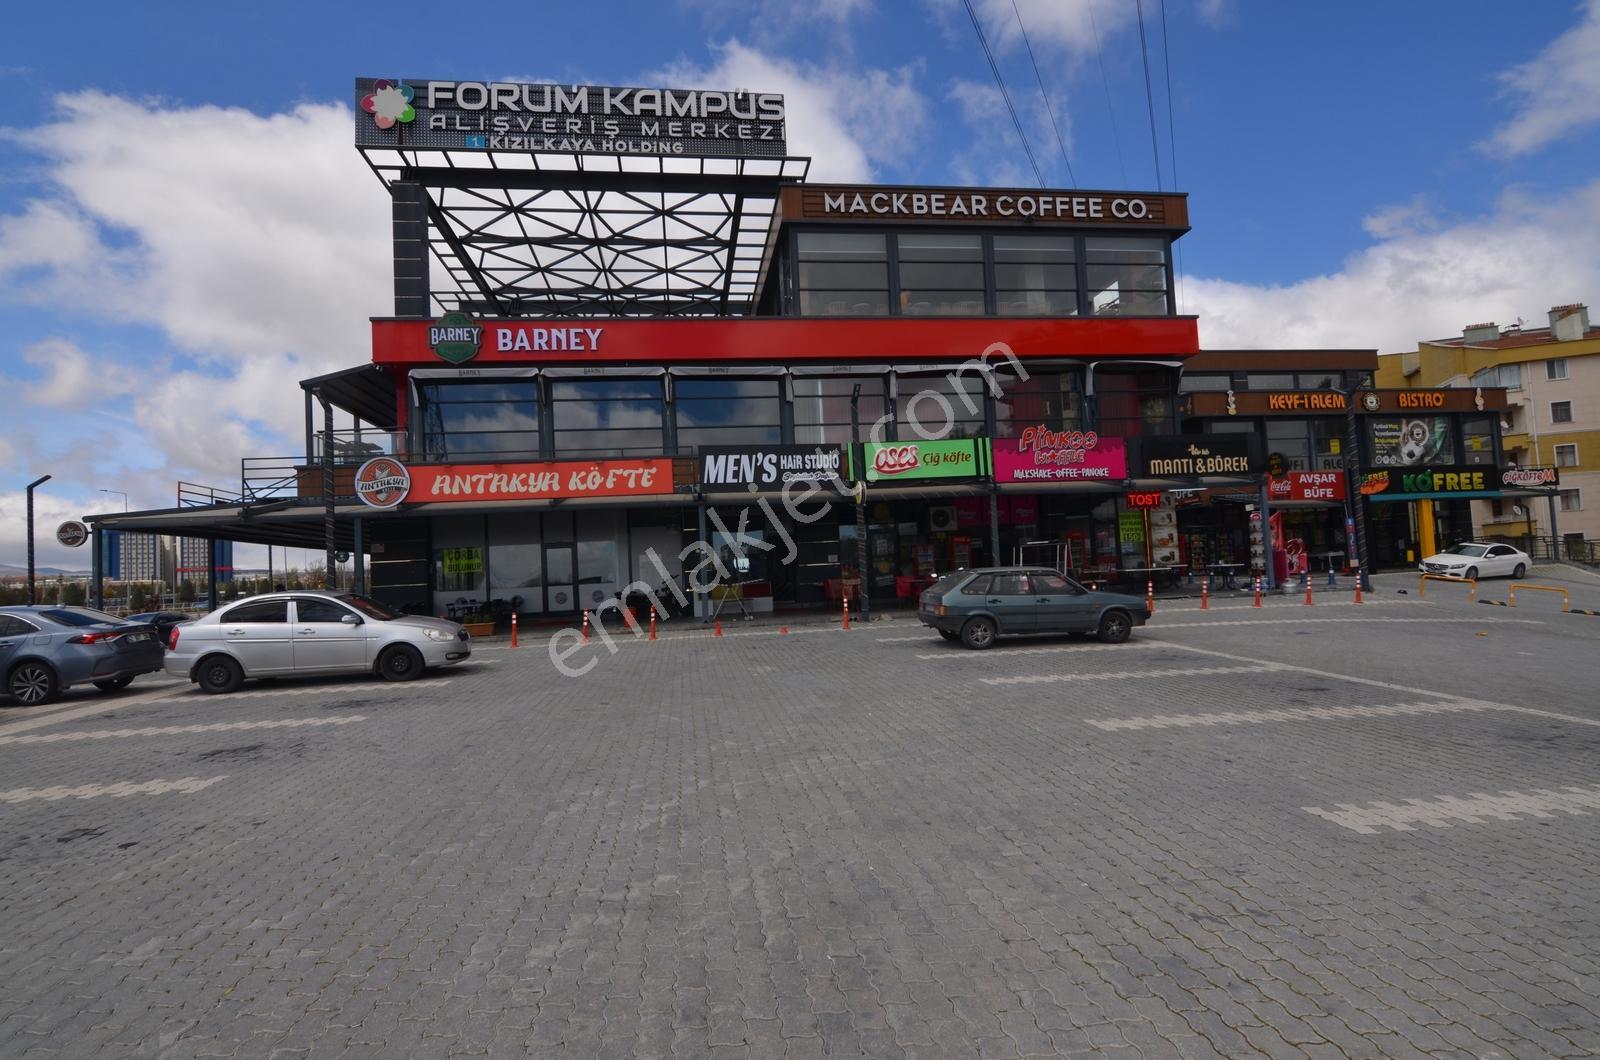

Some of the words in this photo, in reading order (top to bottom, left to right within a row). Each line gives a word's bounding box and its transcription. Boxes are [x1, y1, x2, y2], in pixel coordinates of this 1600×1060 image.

[428, 81, 589, 114] FORUM
[603, 87, 785, 121] KAMPÜS
[430, 114, 620, 139] ALIŞVERİŞ
[489, 135, 596, 151] KIZILKAYA
[824, 191, 989, 216] MACKBEAR
[995, 195, 1104, 219] COFFEE
[1111, 199, 1154, 220] CO.
[431, 327, 480, 345] BARNEY
[496, 327, 603, 352] BARNEY
[1310, 394, 1345, 409] ALEM
[922, 452, 941, 467] Çiğ
[942, 450, 972, 465] köfte
[1195, 457, 1206, 474] &
[1206, 455, 1249, 473] BÖREK
[360, 476, 404, 491] ANTAKYA
[430, 471, 561, 496] ANTAKYA
[568, 465, 658, 491] KÖFTE
[1298, 473, 1337, 486] AVŞAR
[1128, 493, 1161, 505] TOST
[1303, 486, 1334, 498] BÜFE
